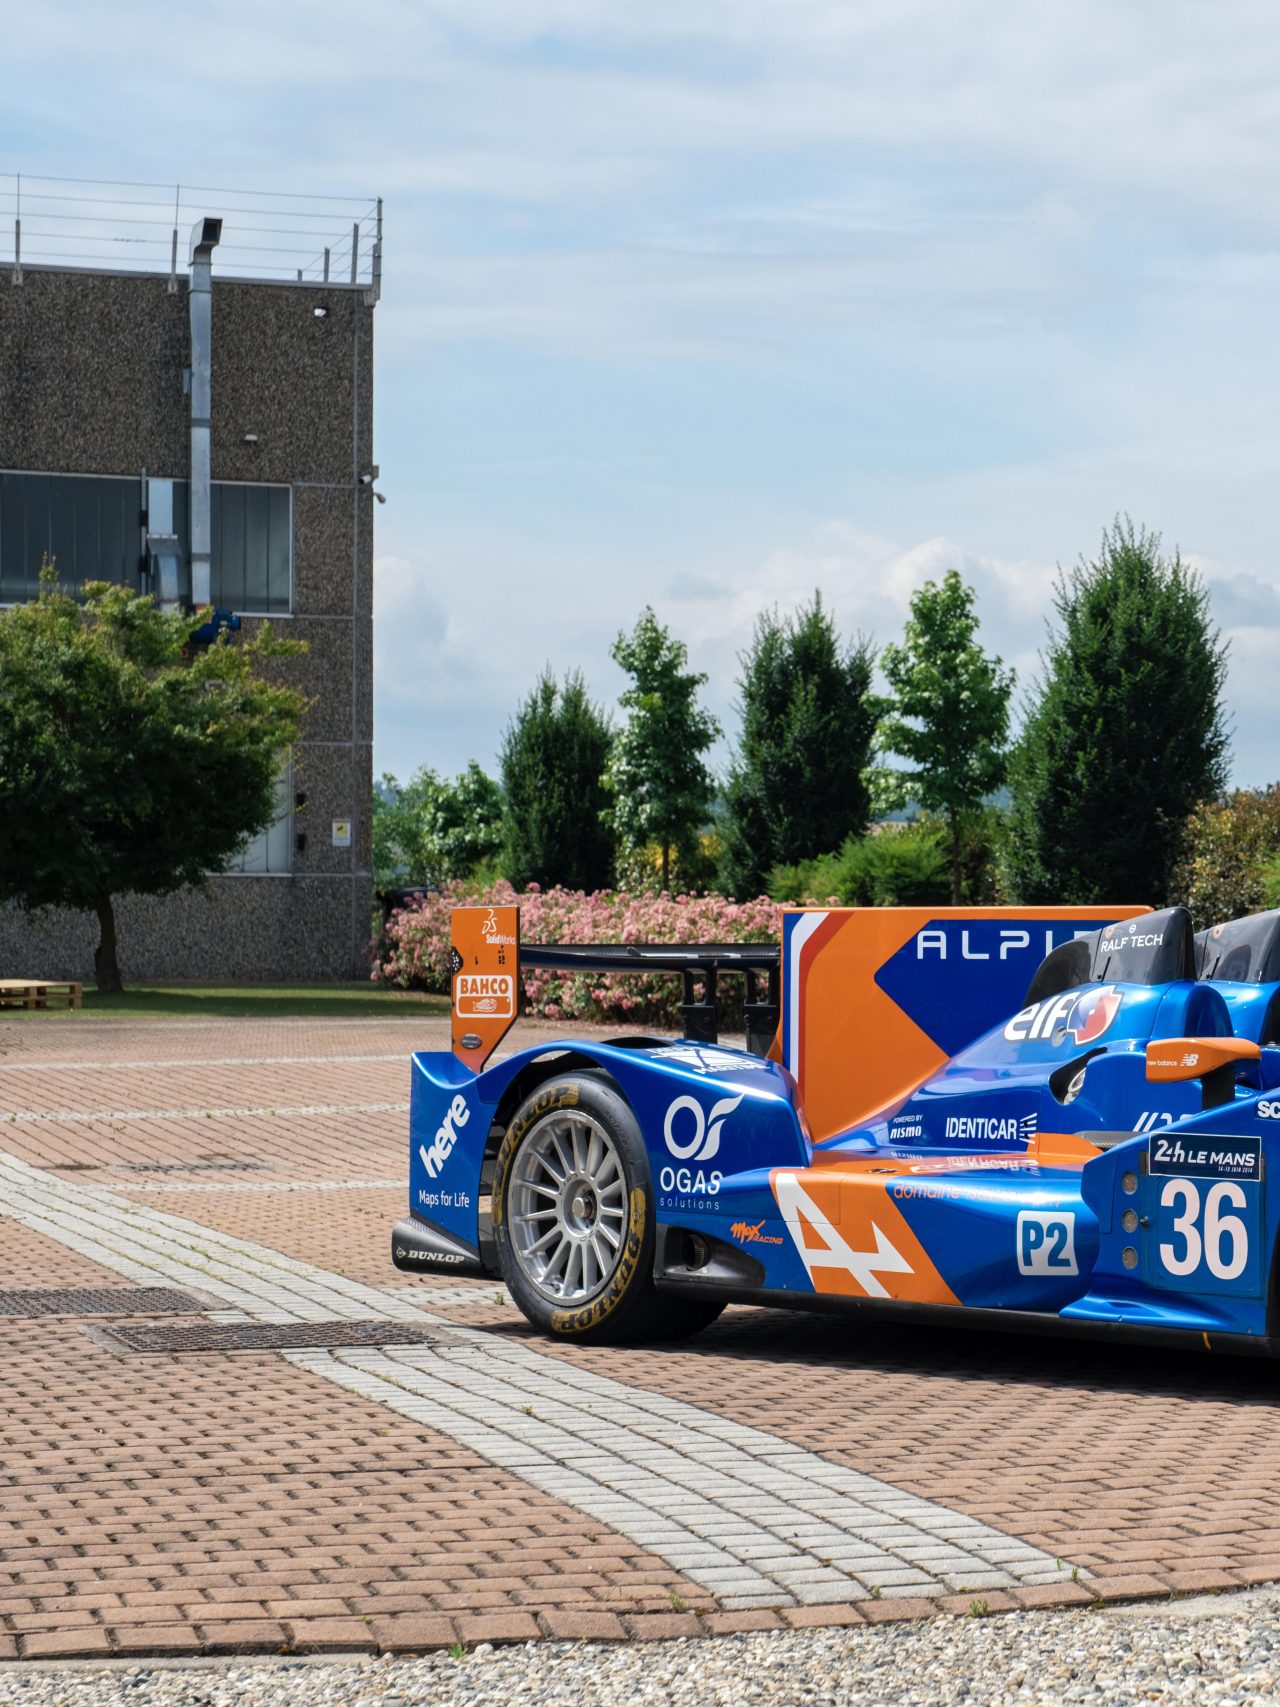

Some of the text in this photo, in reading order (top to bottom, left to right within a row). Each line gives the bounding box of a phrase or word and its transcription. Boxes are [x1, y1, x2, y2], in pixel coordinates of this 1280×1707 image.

[917, 931, 1094, 960] ALPI
[1101, 934, 1163, 952] RALF TECH
[460, 978, 509, 995] BAHCO
[1004, 991, 1083, 1040] elf
[893, 1115, 915, 1123] POWERED
[419, 1094, 470, 1178] here
[945, 1118, 1017, 1139] IDENTICAR
[1187, 1151, 1208, 1164] LE
[1210, 1152, 1255, 1166] MANS
[659, 1167, 724, 1195] OGAS
[419, 1190, 470, 1208] Maps for Life
[660, 1196, 720, 1210] solutions
[1159, 1178, 1249, 1280] 36
[752, 1234, 784, 1245] RACING
[1022, 1220, 1072, 1268] P2
[407, 1249, 465, 1263] DUNLOP
